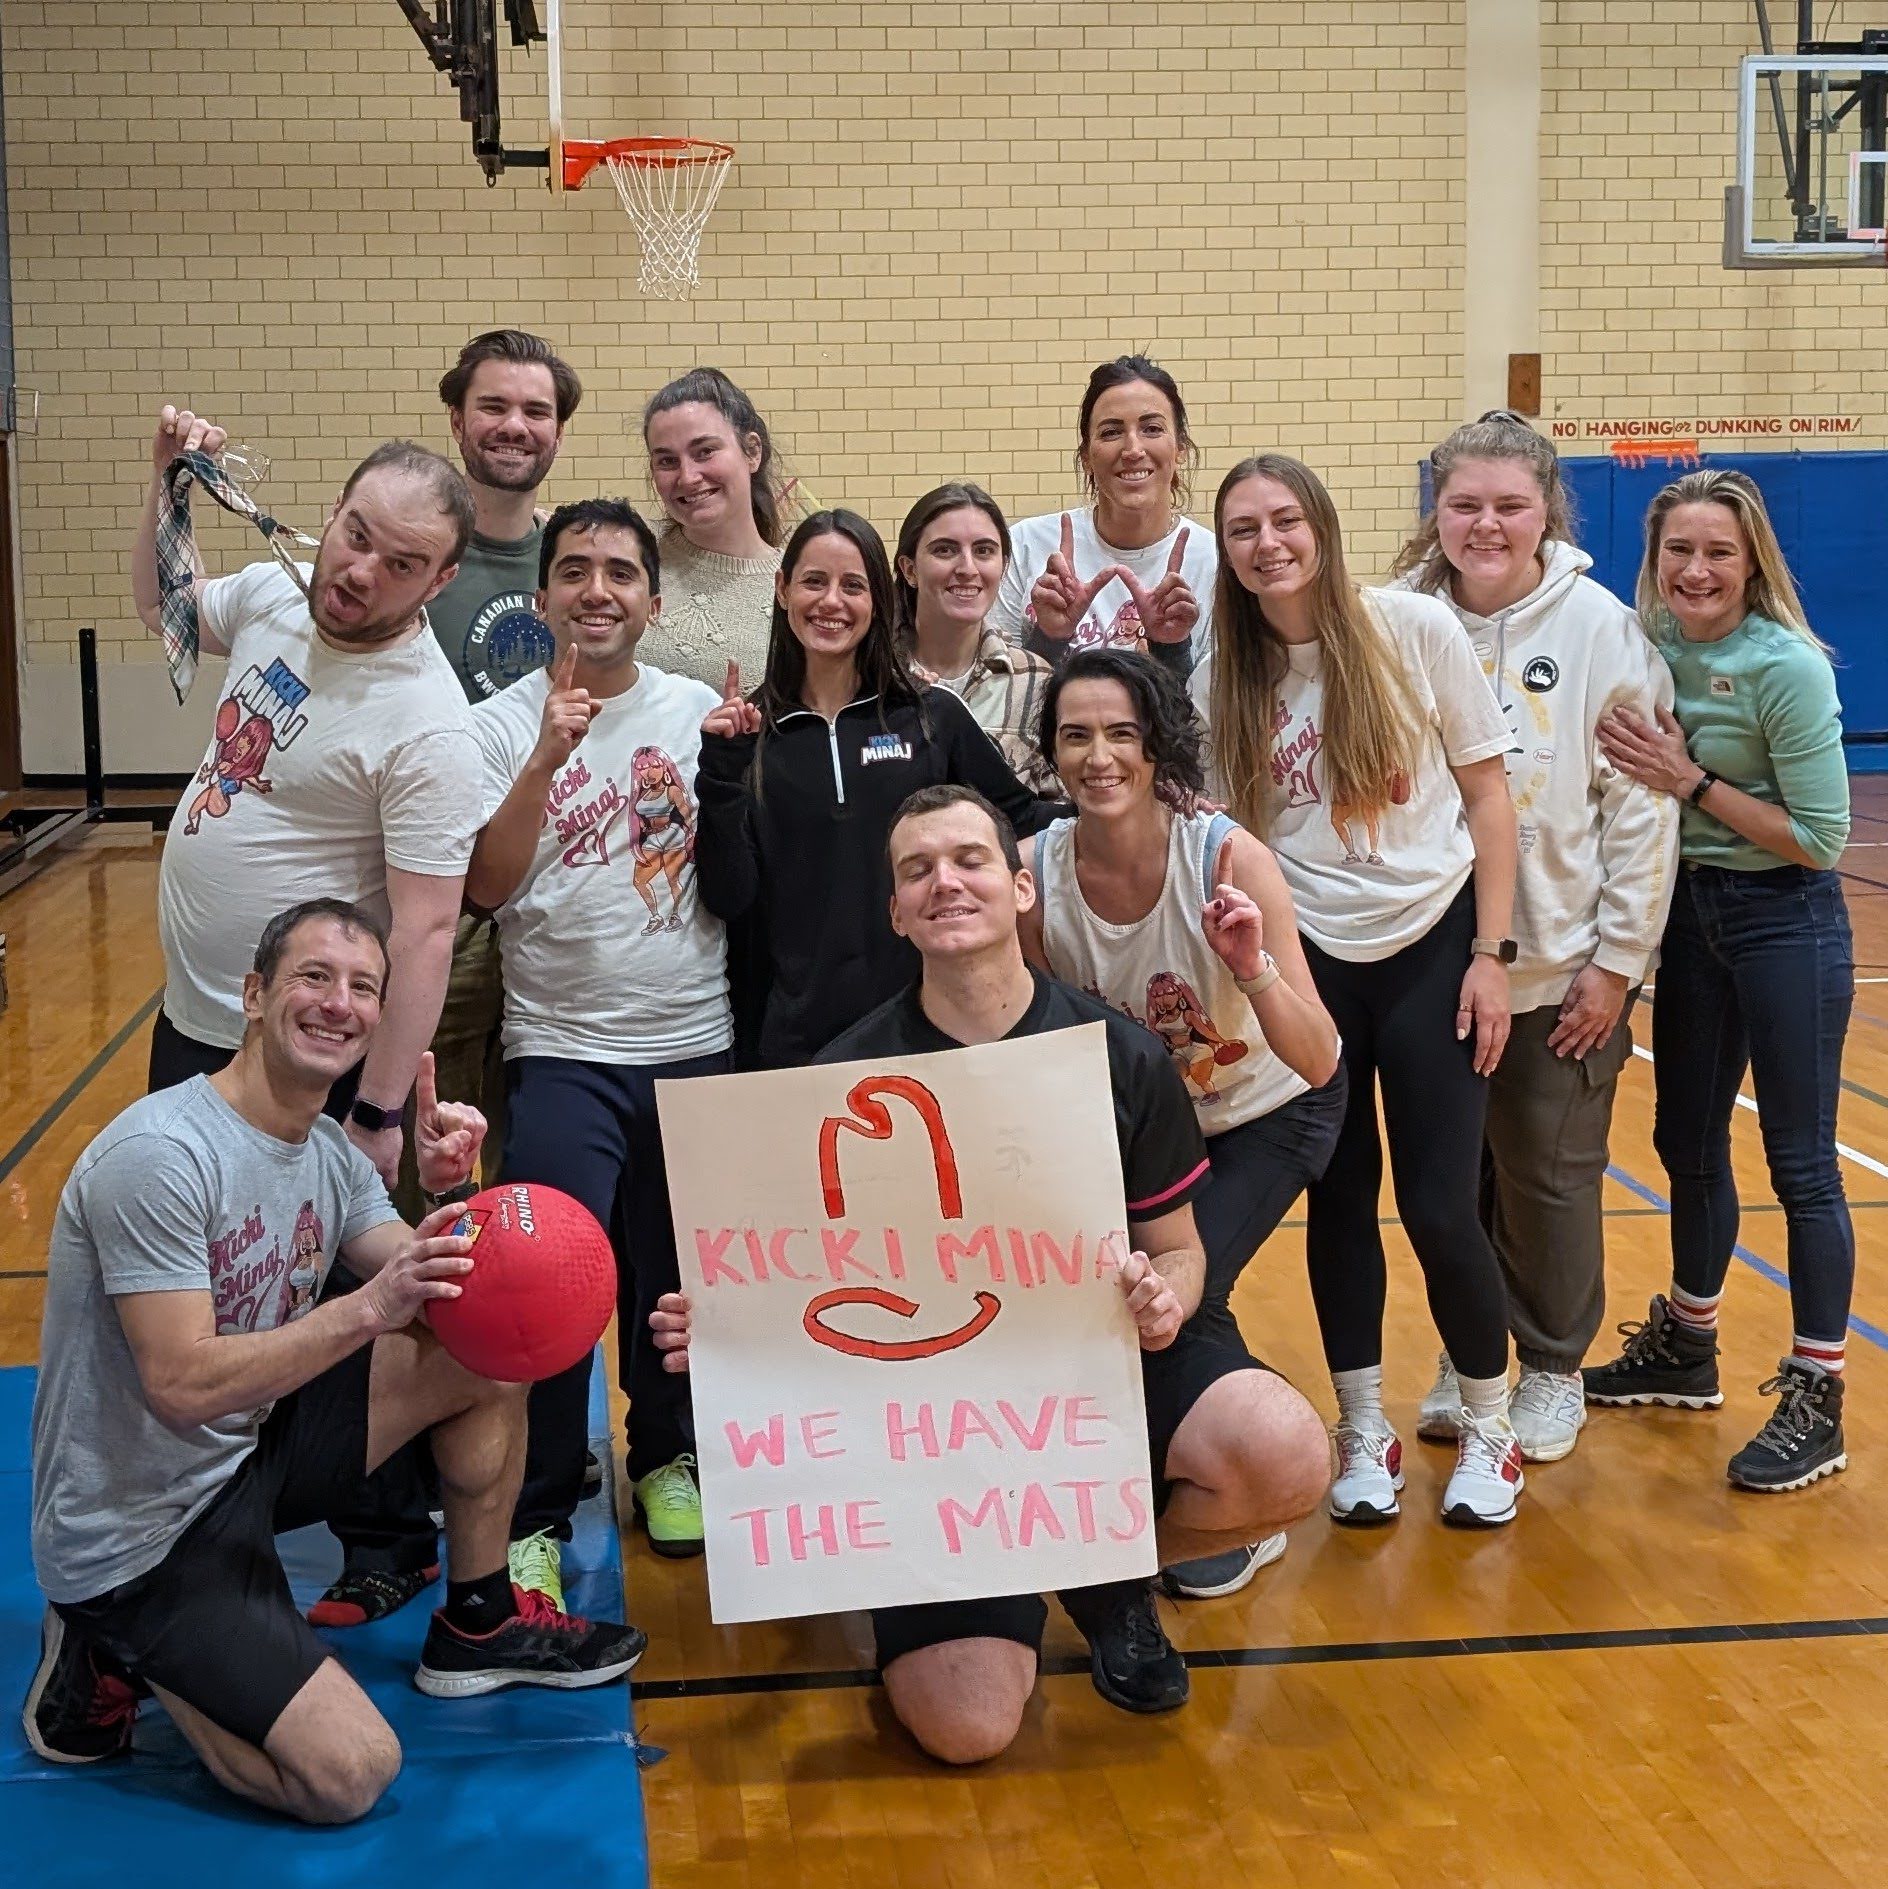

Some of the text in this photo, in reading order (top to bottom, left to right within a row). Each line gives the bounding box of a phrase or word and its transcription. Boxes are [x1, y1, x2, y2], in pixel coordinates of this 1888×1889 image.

[1552, 422, 1577, 437] NO
[1585, 420, 1674, 437] HANGING
[1695, 418, 1783, 435] DUNKING
[1789, 418, 1813, 433] ON
[471, 595, 525, 644] CANADIAN
[230, 664, 309, 752] MINAJ
[861, 742, 913, 766] MINAJ
[555, 777, 626, 845] Minaj
[512, 1186, 536, 1237] RHINO
[215, 1234, 284, 1308] Minaj
[695, 1227, 906, 1287] KICKI
[724, 1395, 1109, 1469] WE HAVE
[729, 1477, 1151, 1567] THE MATS
